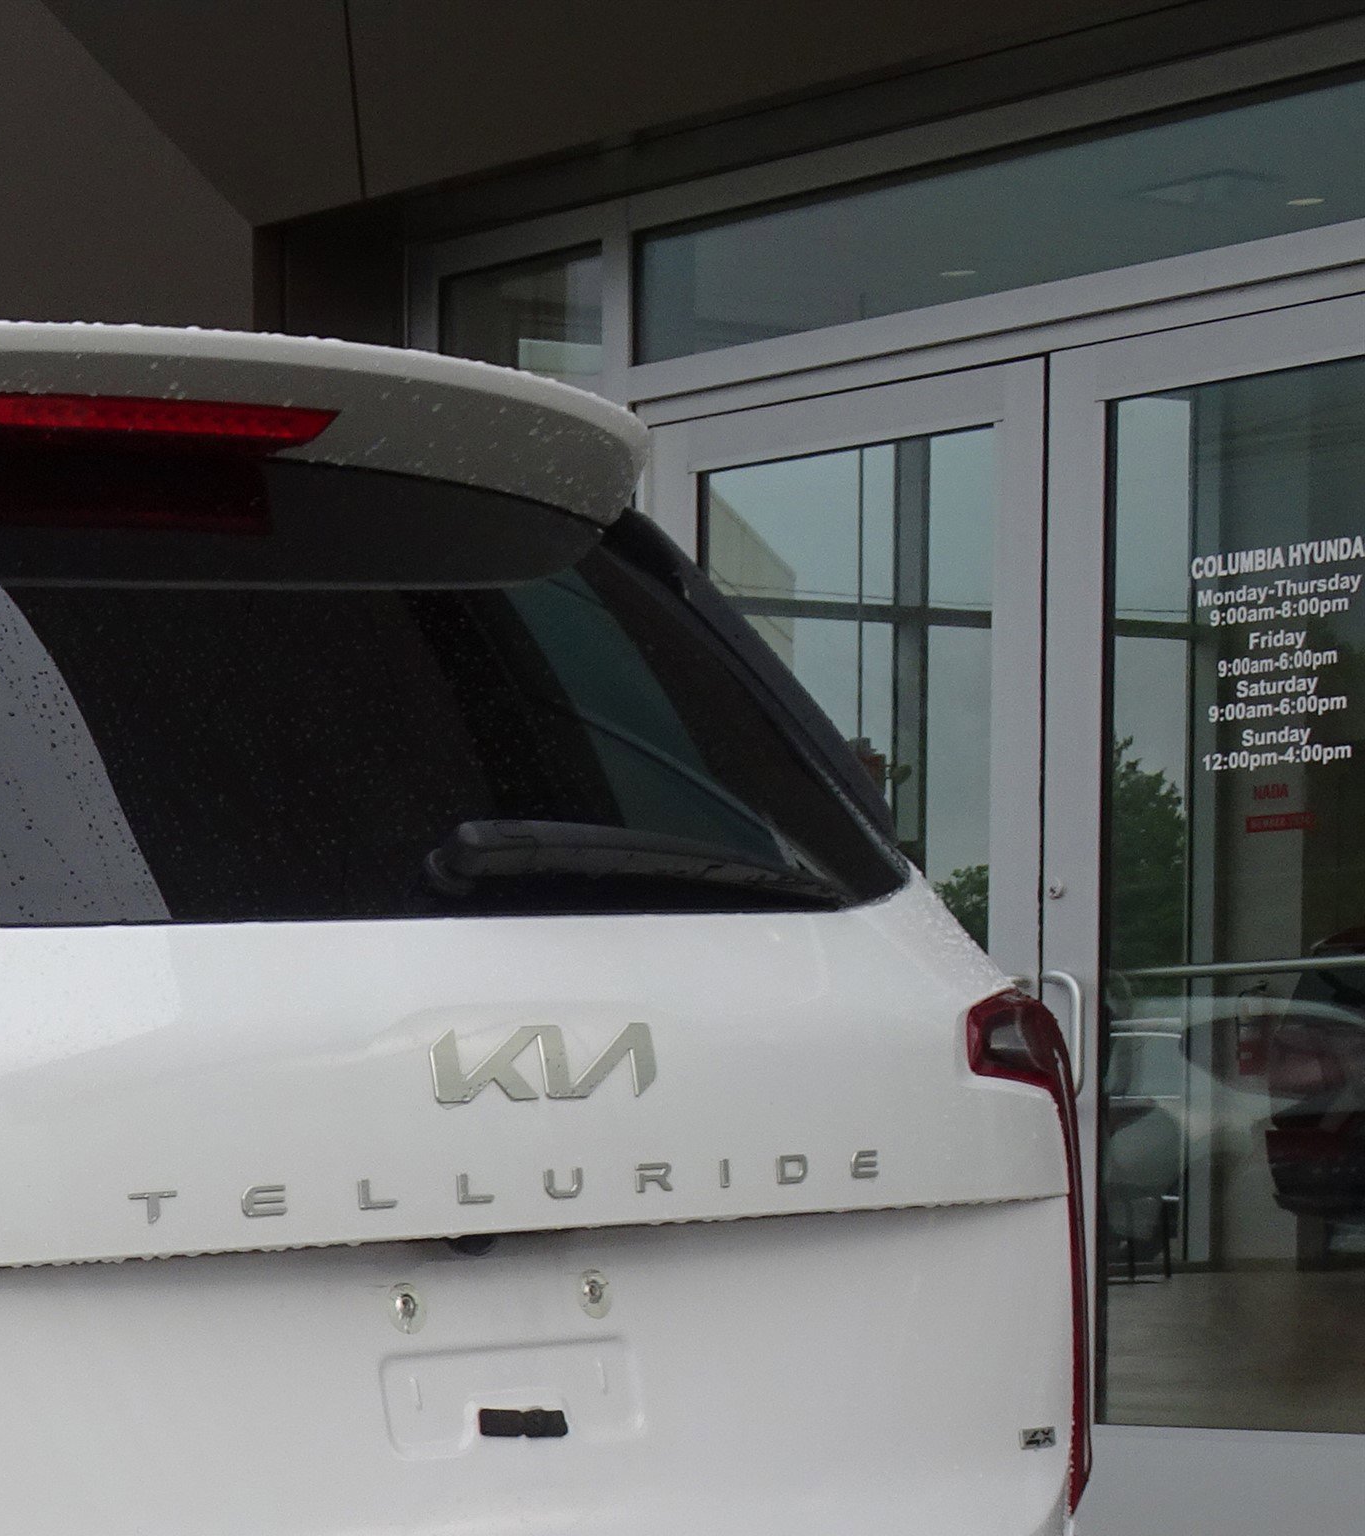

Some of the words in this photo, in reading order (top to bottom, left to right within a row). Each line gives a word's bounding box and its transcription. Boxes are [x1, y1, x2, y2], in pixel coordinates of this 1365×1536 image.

[1191, 546, 1286, 580] COLUMBIA
[1288, 535, 1365, 568] HYUNDA
[1197, 573, 1362, 608] Monday-Thursday
[1209, 597, 1349, 627] 9:00am-8:00pm
[1248, 629, 1307, 650] Friday
[1218, 649, 1338, 678] 9:00am-6:00pm
[1236, 675, 1319, 699] Saturday
[1208, 695, 1348, 723] 9:00am-6:00pm
[1241, 726, 1311, 747] Sunday
[1202, 744, 1353, 772] 12:00pm-4:00pm
[427, 1021, 658, 1106] KIA
[126, 1148, 879, 1225] TELLURIDE
